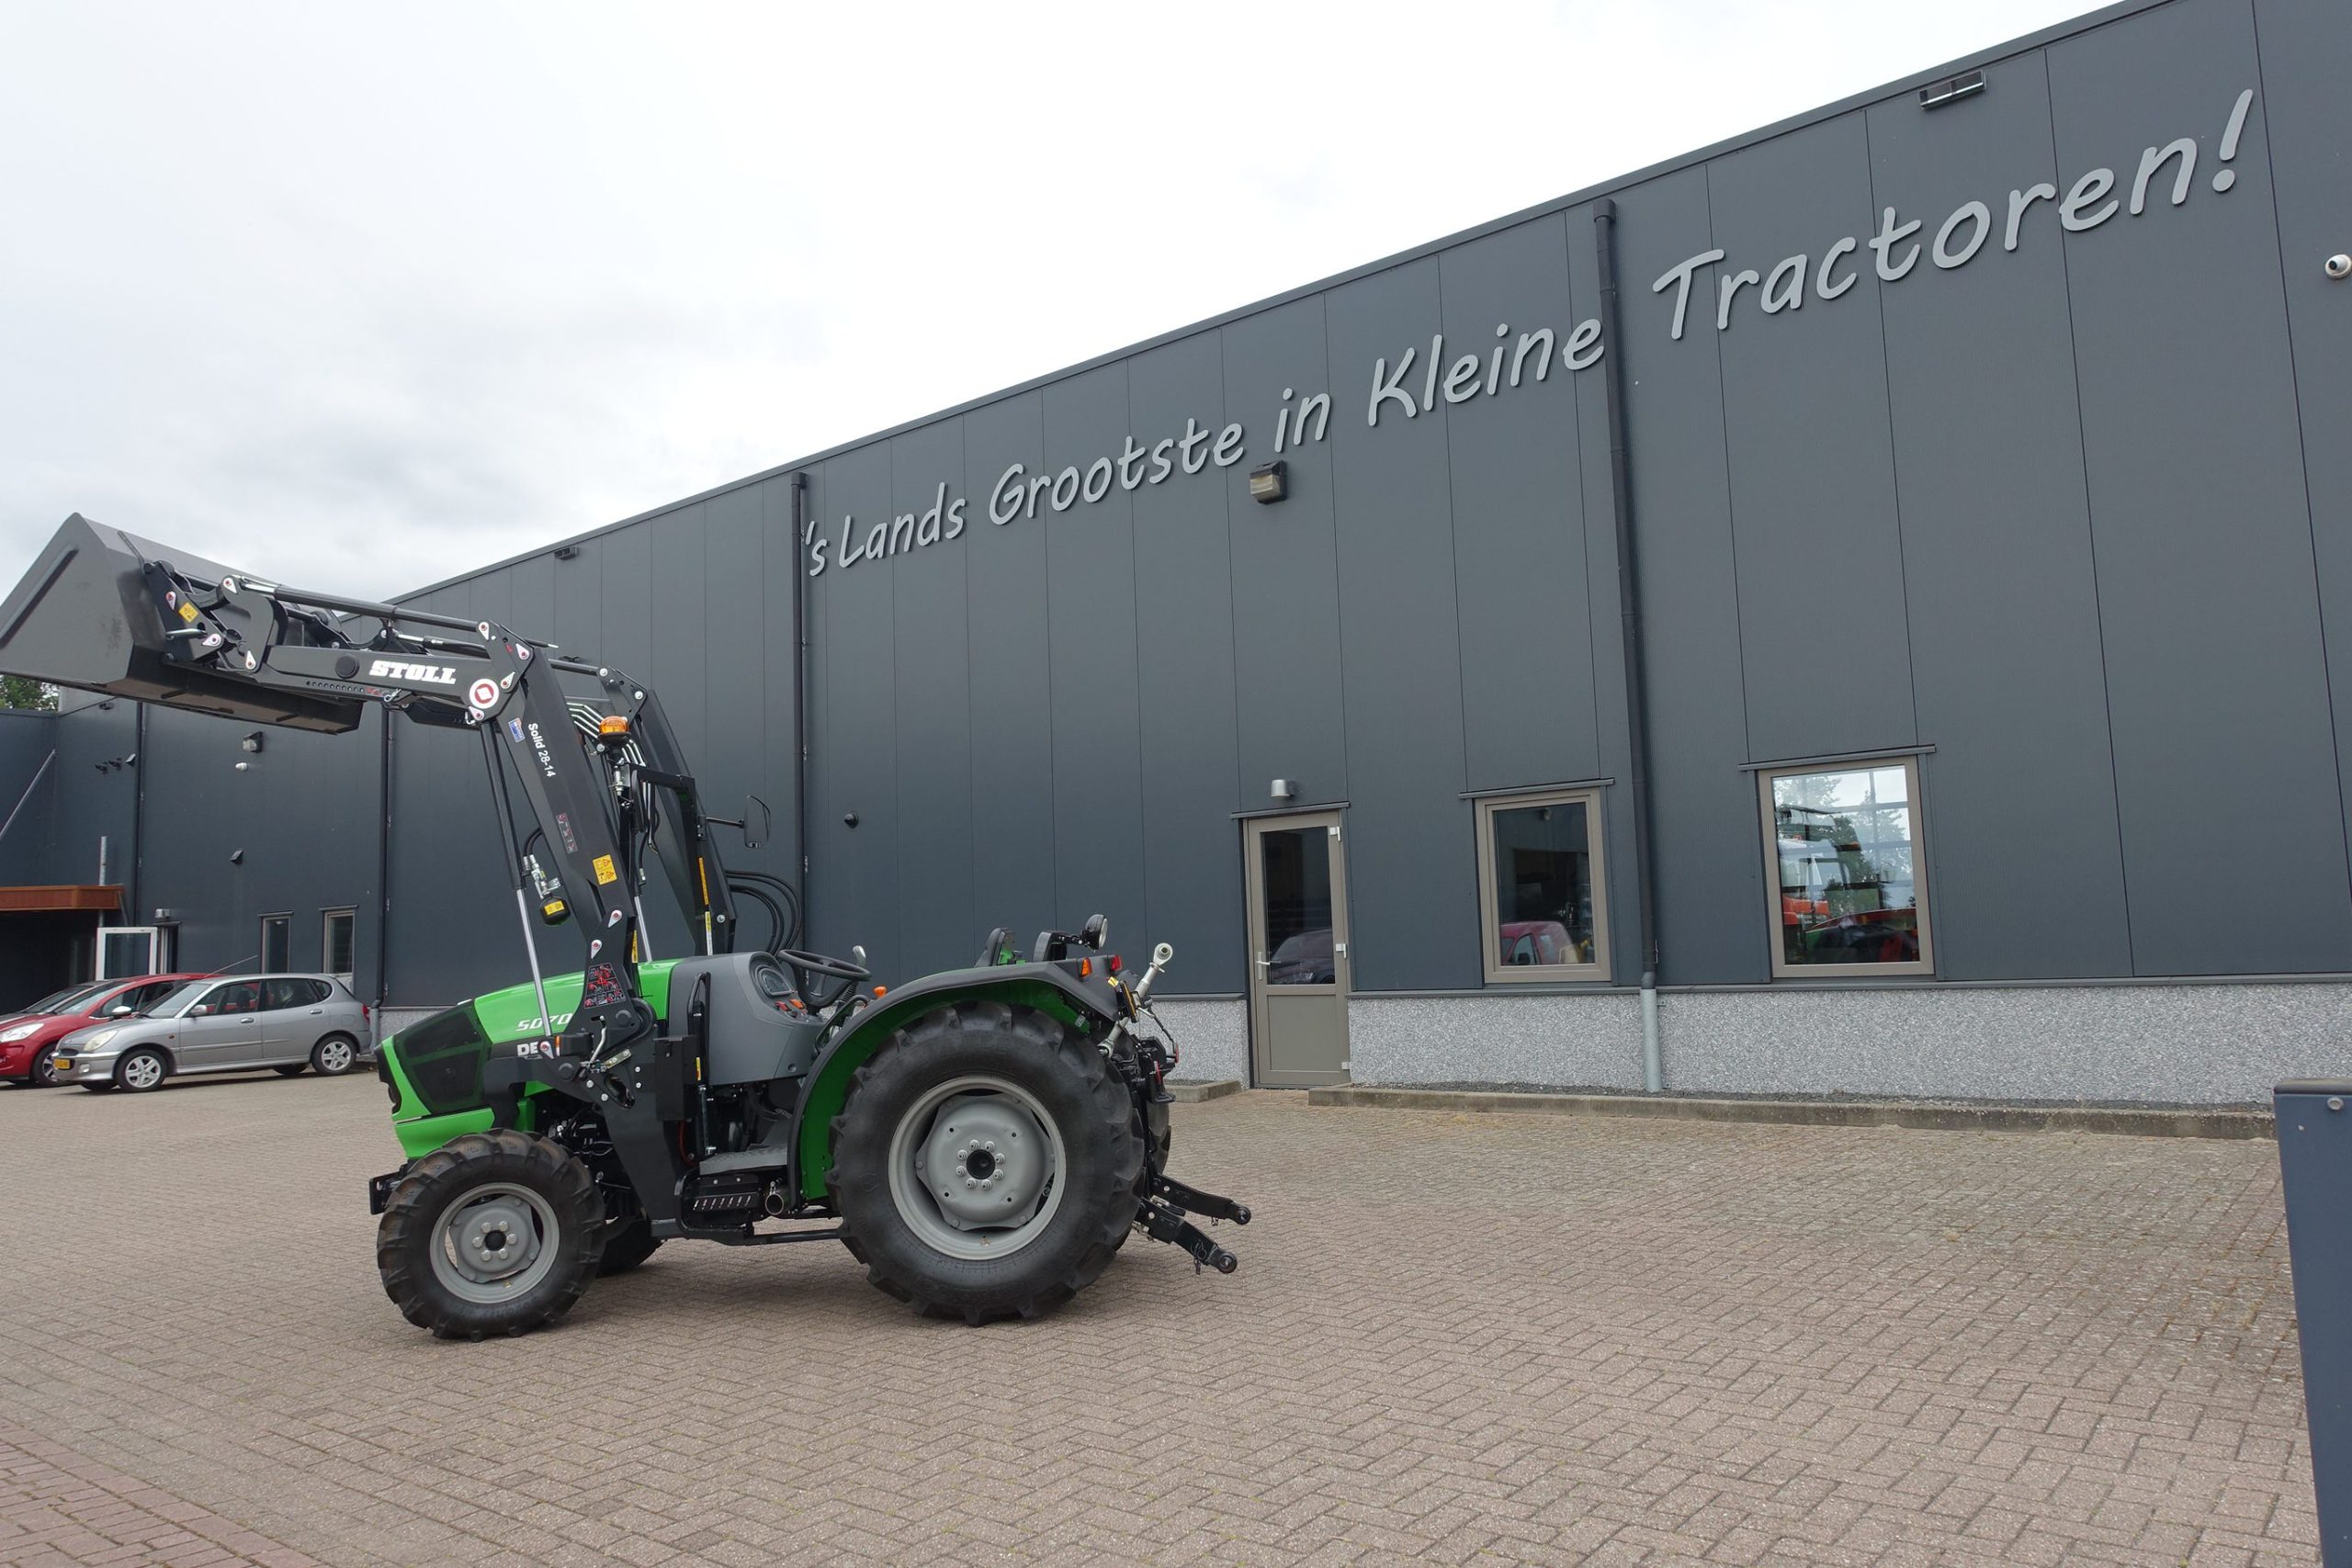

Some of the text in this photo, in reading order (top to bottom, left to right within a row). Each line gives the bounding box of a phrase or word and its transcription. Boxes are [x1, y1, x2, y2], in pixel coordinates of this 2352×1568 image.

[806, 89, 2253, 577] 's Lands Grootste in Kleine Tractoren!
[368, 660, 457, 684] STOLL
[527, 722, 557, 778] Solid 28-14
[516, 1041, 539, 1056] DE
